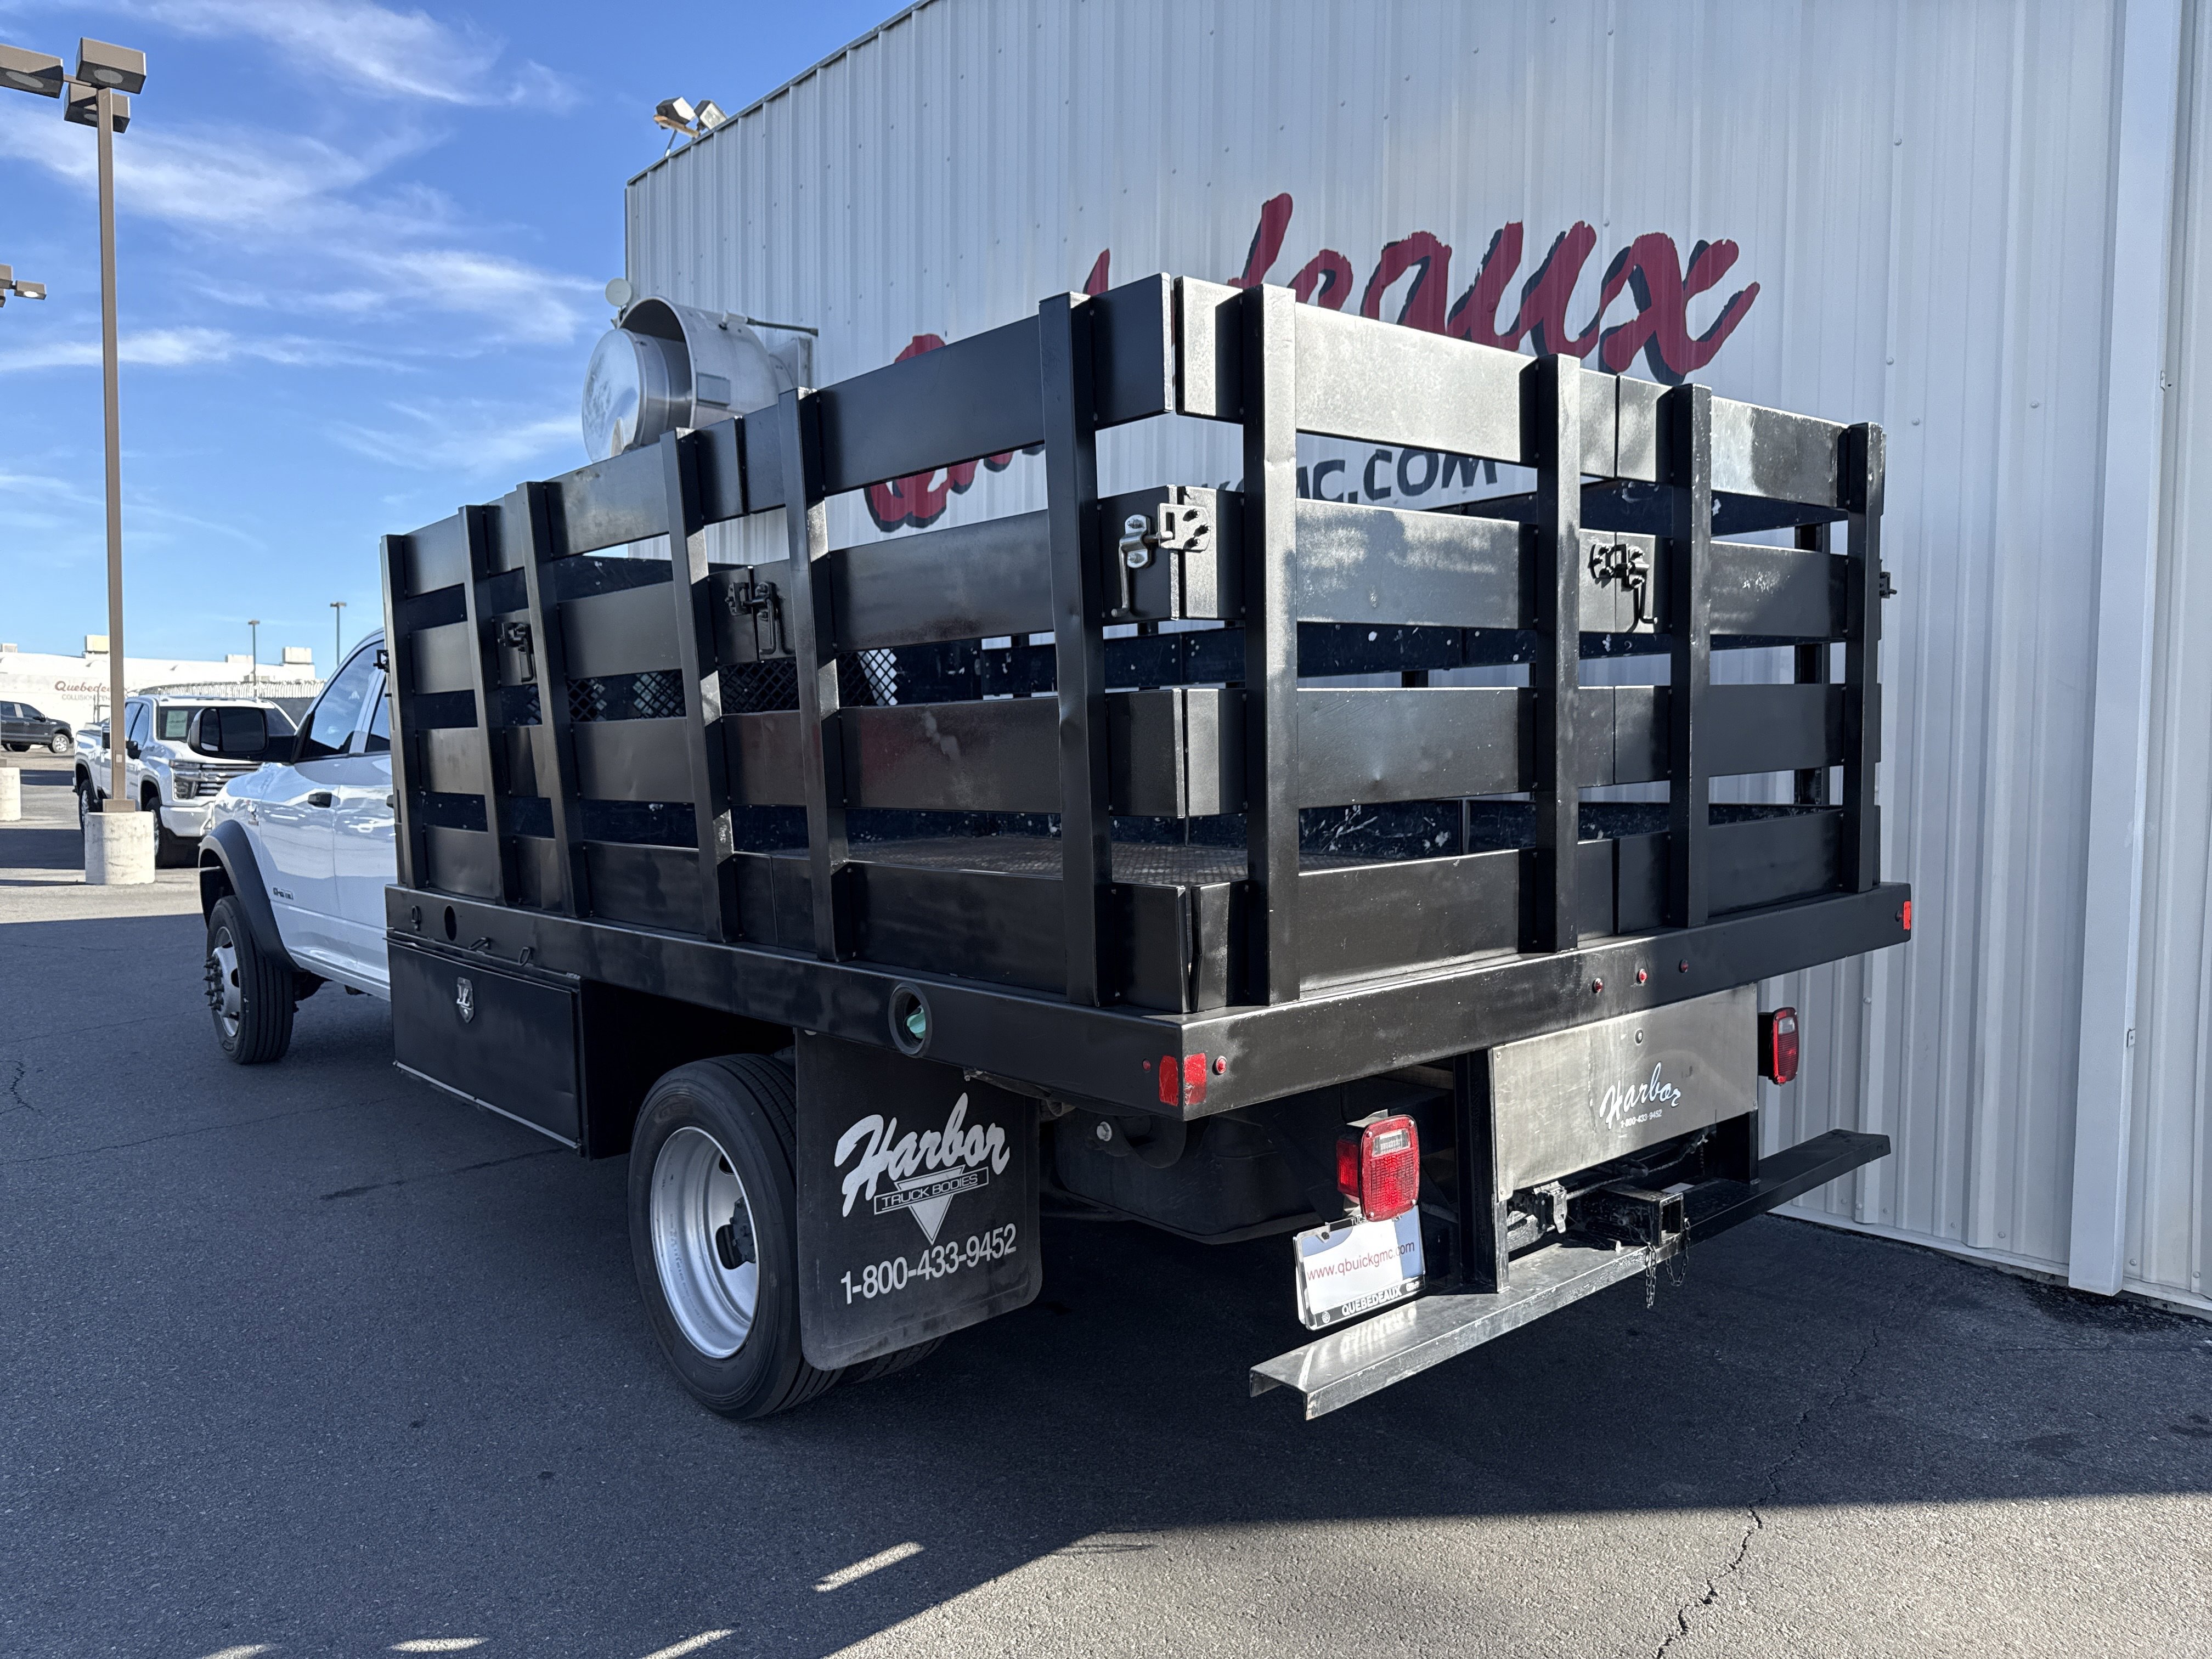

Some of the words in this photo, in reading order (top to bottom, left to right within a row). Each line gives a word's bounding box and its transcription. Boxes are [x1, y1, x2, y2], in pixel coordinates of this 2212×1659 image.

[1599, 1062, 1681, 1130] Harbor
[1620, 1109, 1662, 1128] 1-800-433-9452
[834, 1092, 1010, 1217] Harbor
[882, 1186, 929, 1206] TRUCK
[932, 1173, 978, 1195] BODIES
[840, 1223, 1017, 1304] 1-800-433-9452
[1307, 1242, 1415, 1281] www.qbuickgmc.com
[1341, 1285, 1402, 1316] QUEBEDEAUX
